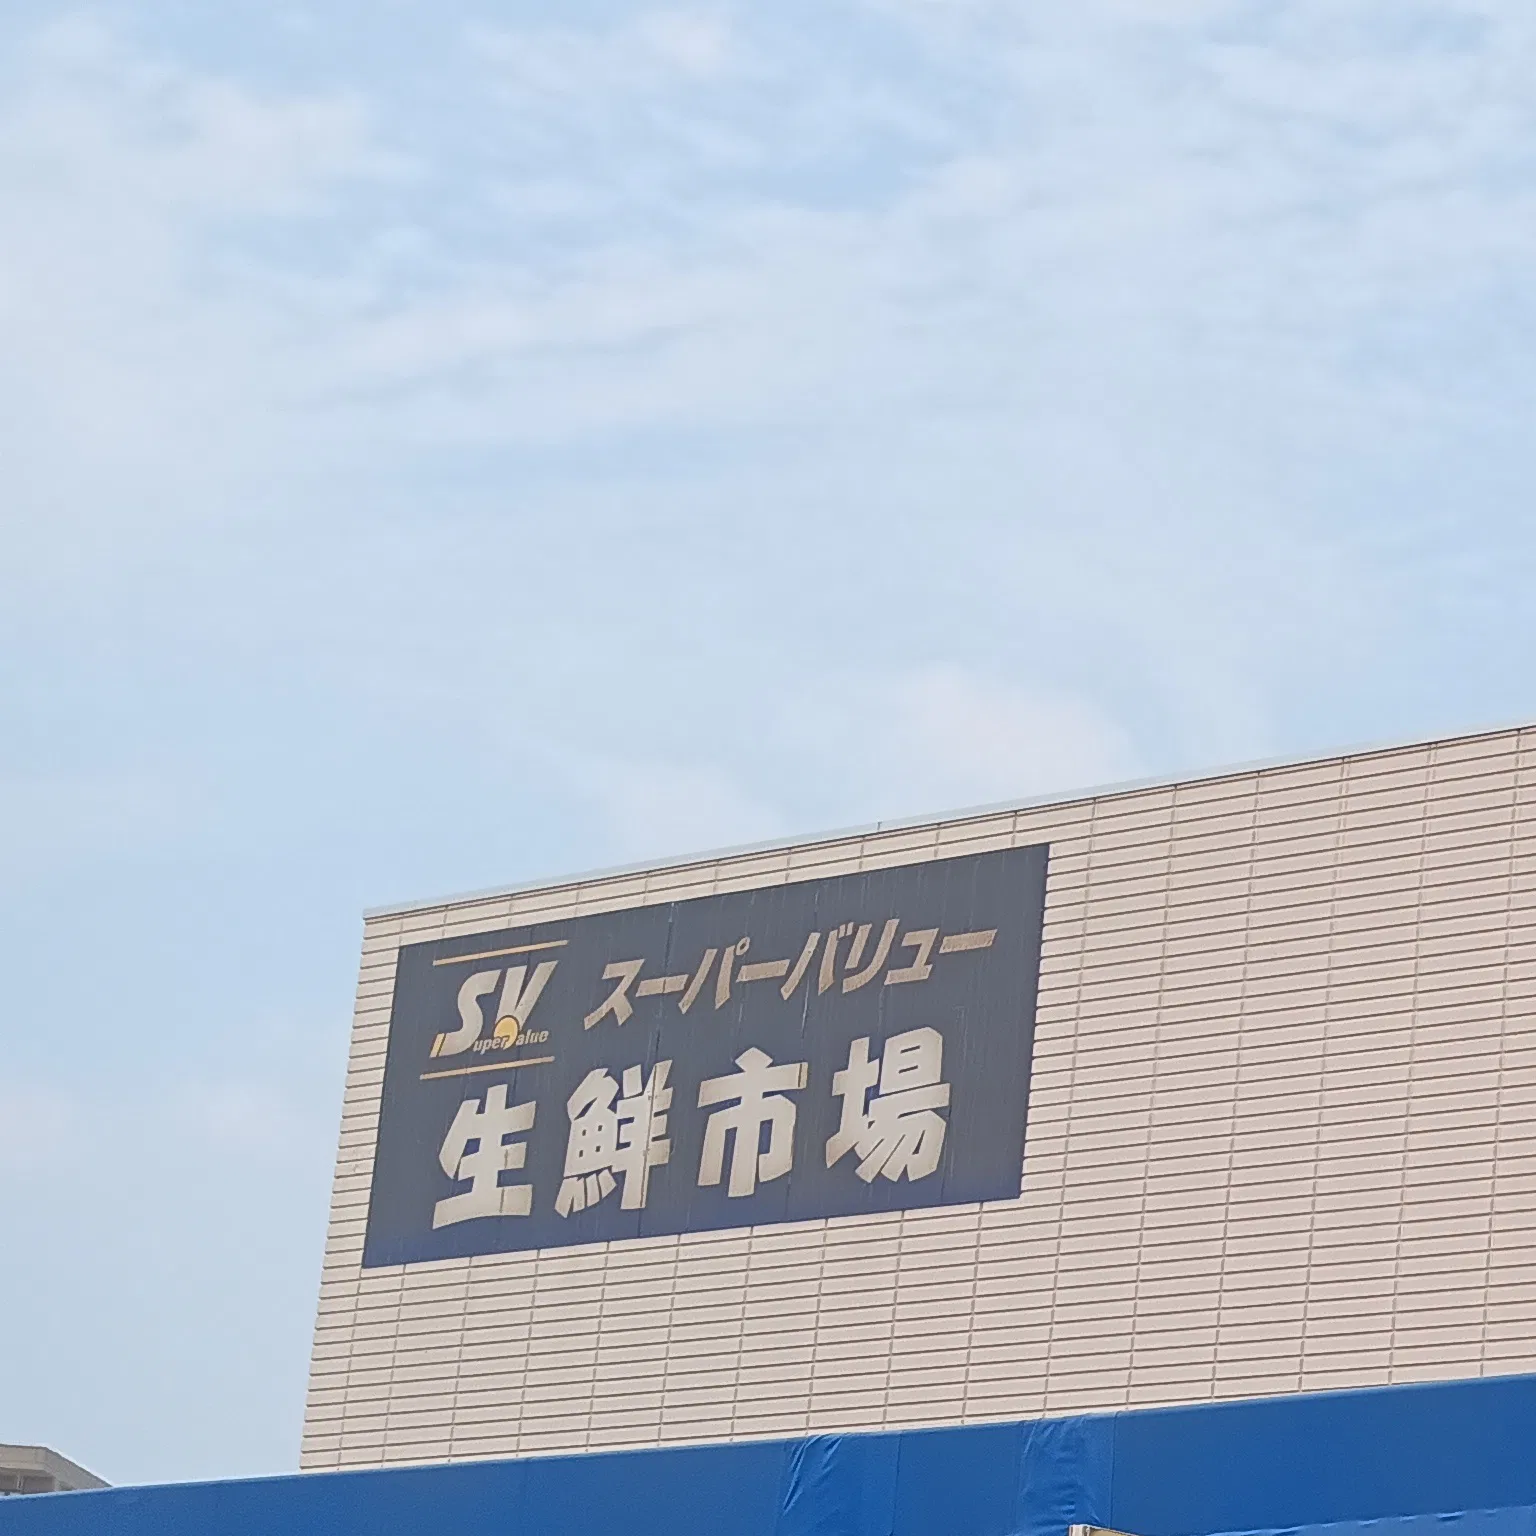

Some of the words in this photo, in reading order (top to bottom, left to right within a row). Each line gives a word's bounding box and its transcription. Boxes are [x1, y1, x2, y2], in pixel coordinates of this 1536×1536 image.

[583, 918, 998, 1030] スーパーバリュー
[432, 1026, 951, 1230] 生鮮市場
